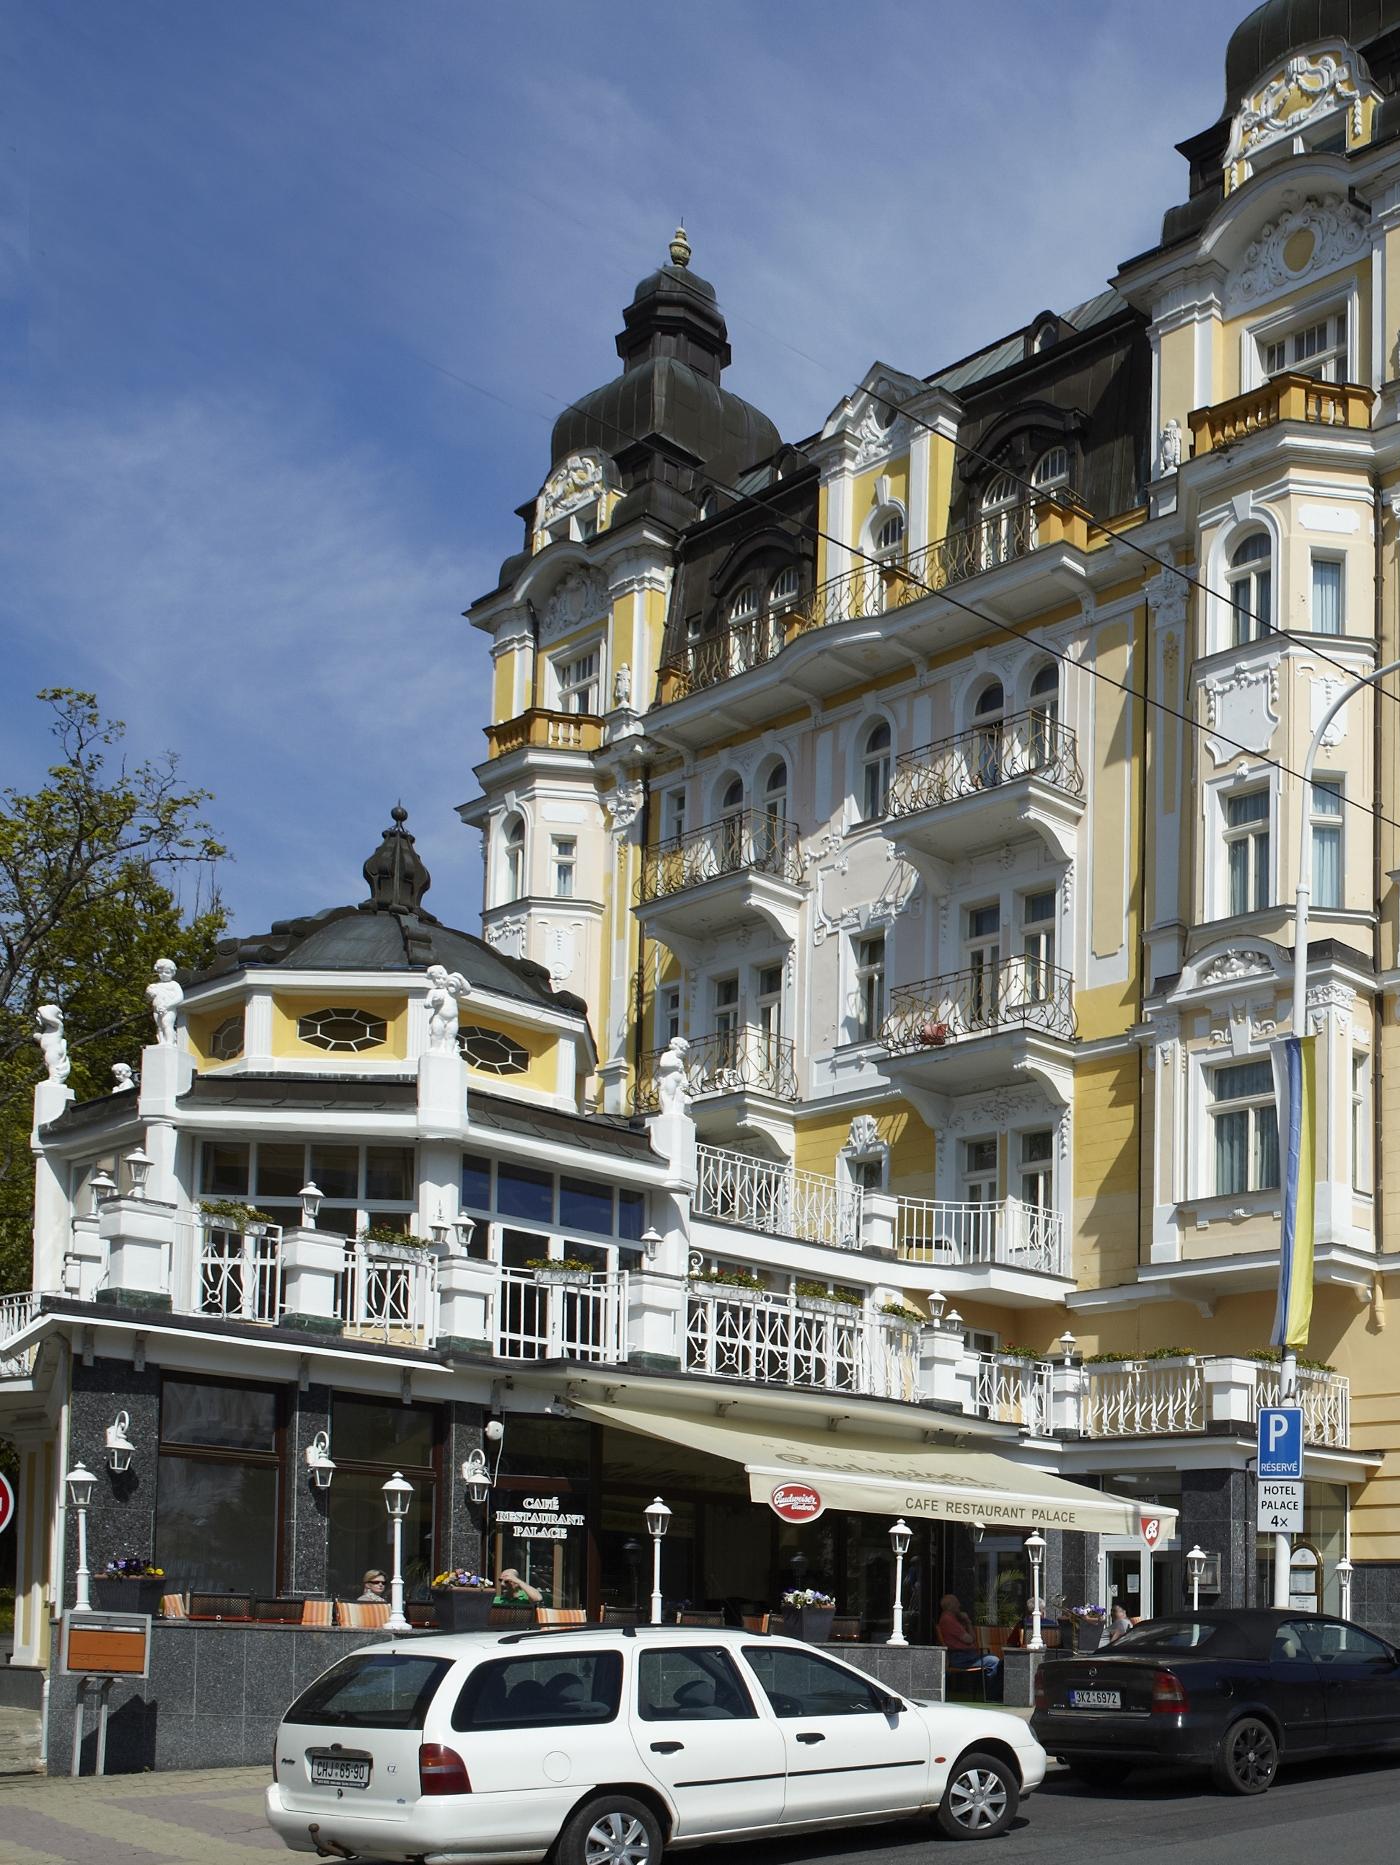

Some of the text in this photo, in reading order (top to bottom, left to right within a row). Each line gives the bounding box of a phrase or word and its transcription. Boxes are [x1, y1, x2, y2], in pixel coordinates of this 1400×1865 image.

[1269, 1414, 1288, 1452] P
[1264, 1486, 1296, 1495] HOTEL
[522, 1496, 560, 1510] CAFÉ
[1261, 1500, 1299, 1511] PALACE
[905, 1497, 1076, 1523] CAFE RESTAURANT PALACE
[496, 1511, 585, 1525] RESTAURANT
[513, 1526, 568, 1539] PALACE
[1096, 1692, 1117, 1704] 6972
